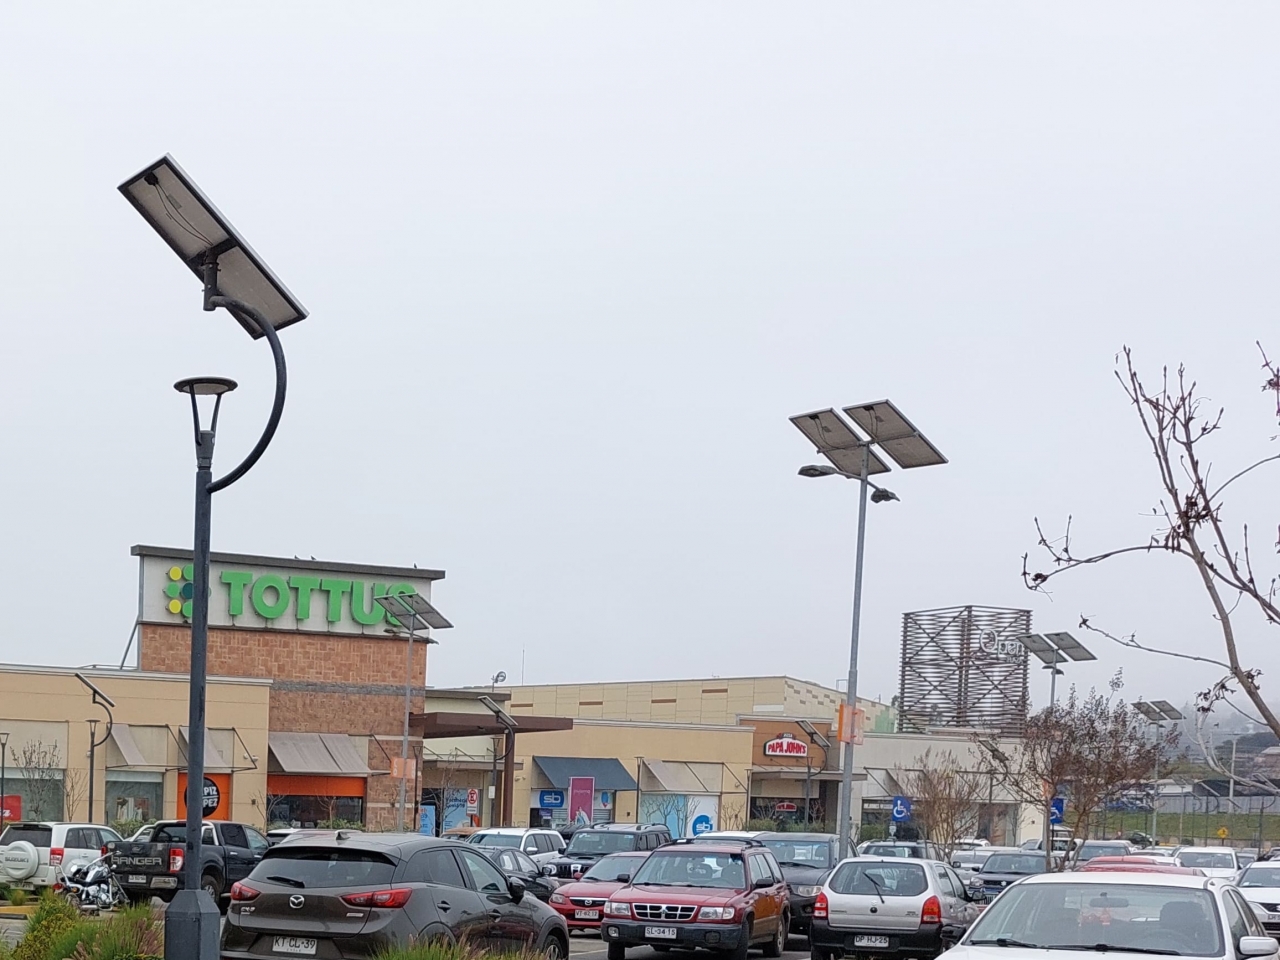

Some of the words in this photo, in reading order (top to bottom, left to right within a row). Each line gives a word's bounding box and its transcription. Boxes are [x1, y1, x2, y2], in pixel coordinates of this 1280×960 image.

[221, 570, 417, 627] TOTTUS
[767, 741, 783, 753] PAPA
[543, 792, 561, 803] sb
[110, 855, 162, 866] RANGER
